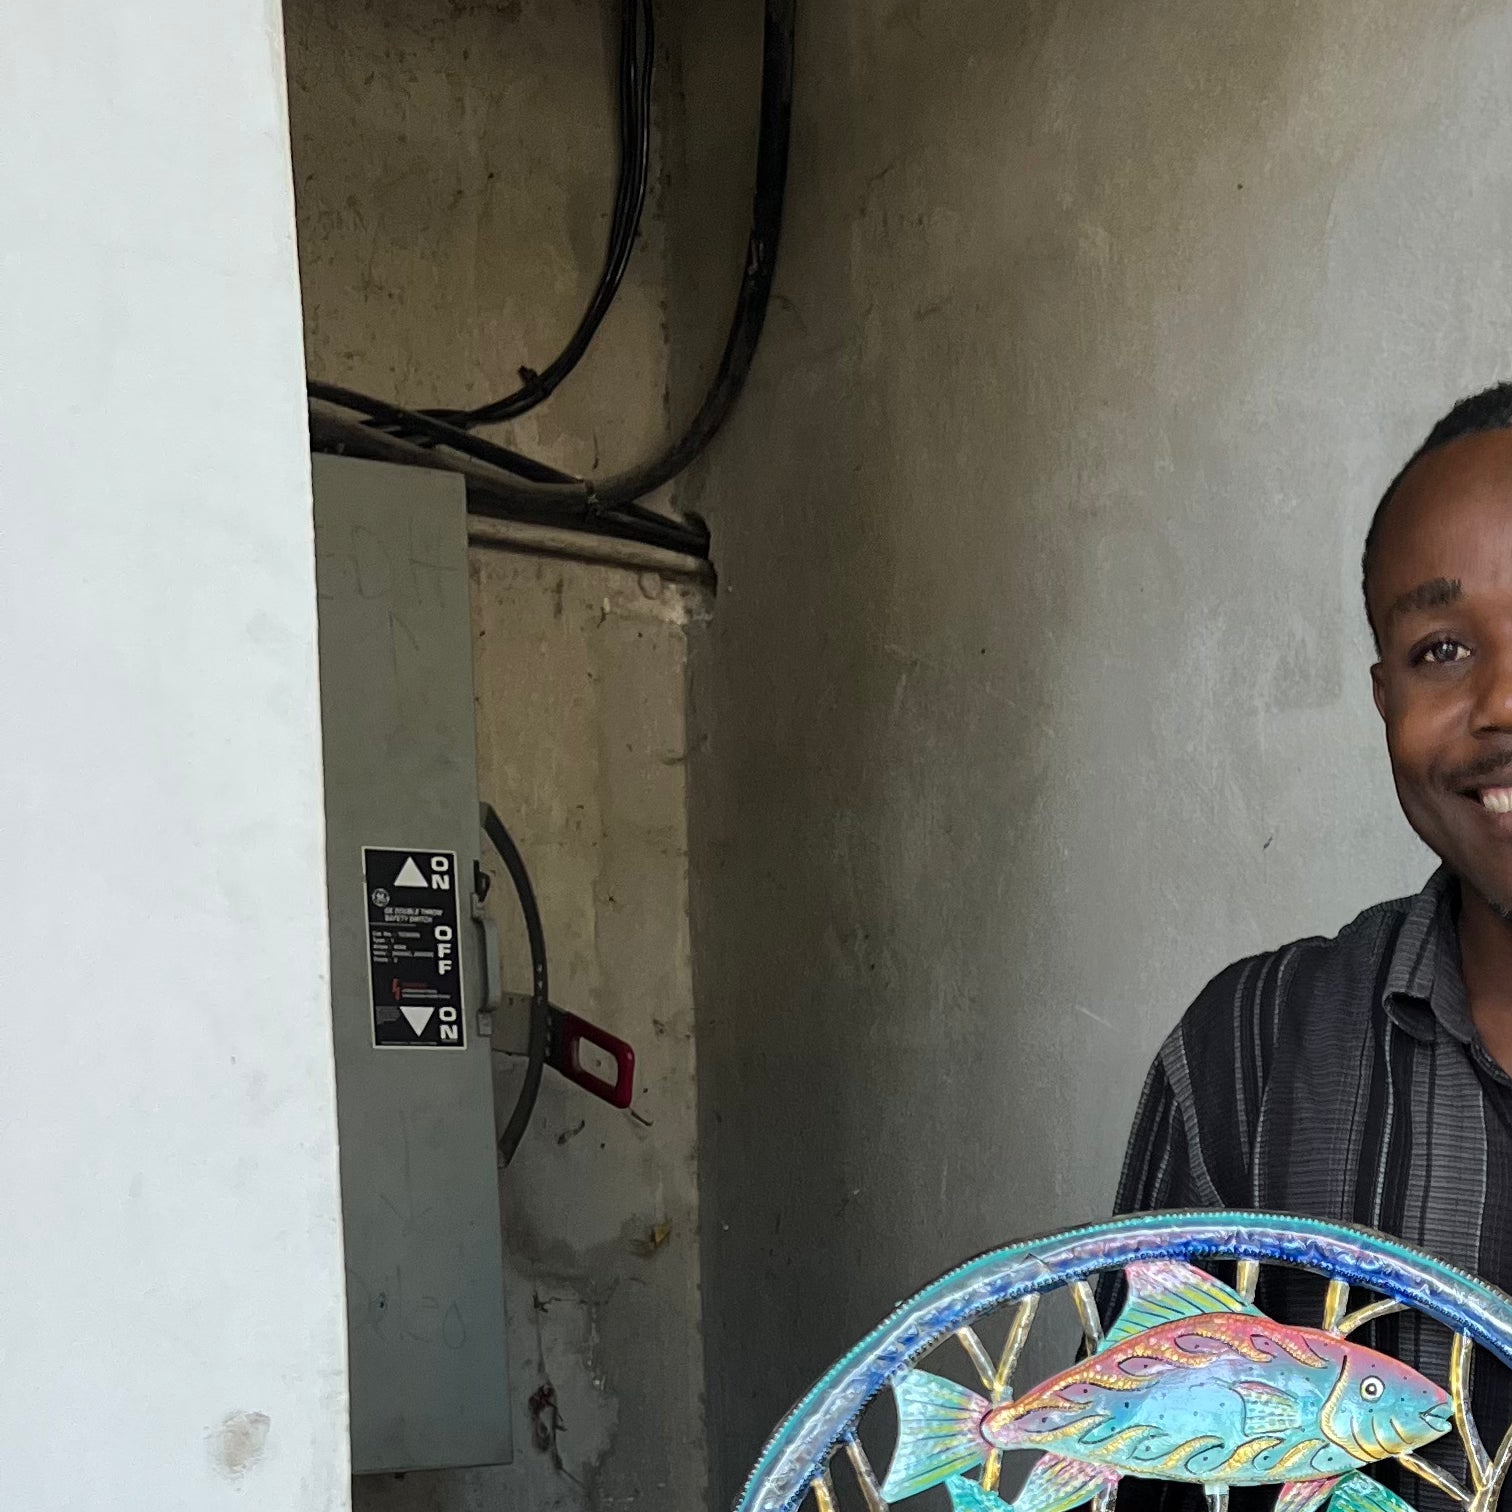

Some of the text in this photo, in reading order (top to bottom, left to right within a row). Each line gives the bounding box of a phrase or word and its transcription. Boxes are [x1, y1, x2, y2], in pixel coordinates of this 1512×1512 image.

[430, 856, 450, 890] ON
[434, 925, 453, 975] OFF
[438, 1006, 458, 1040] ON
